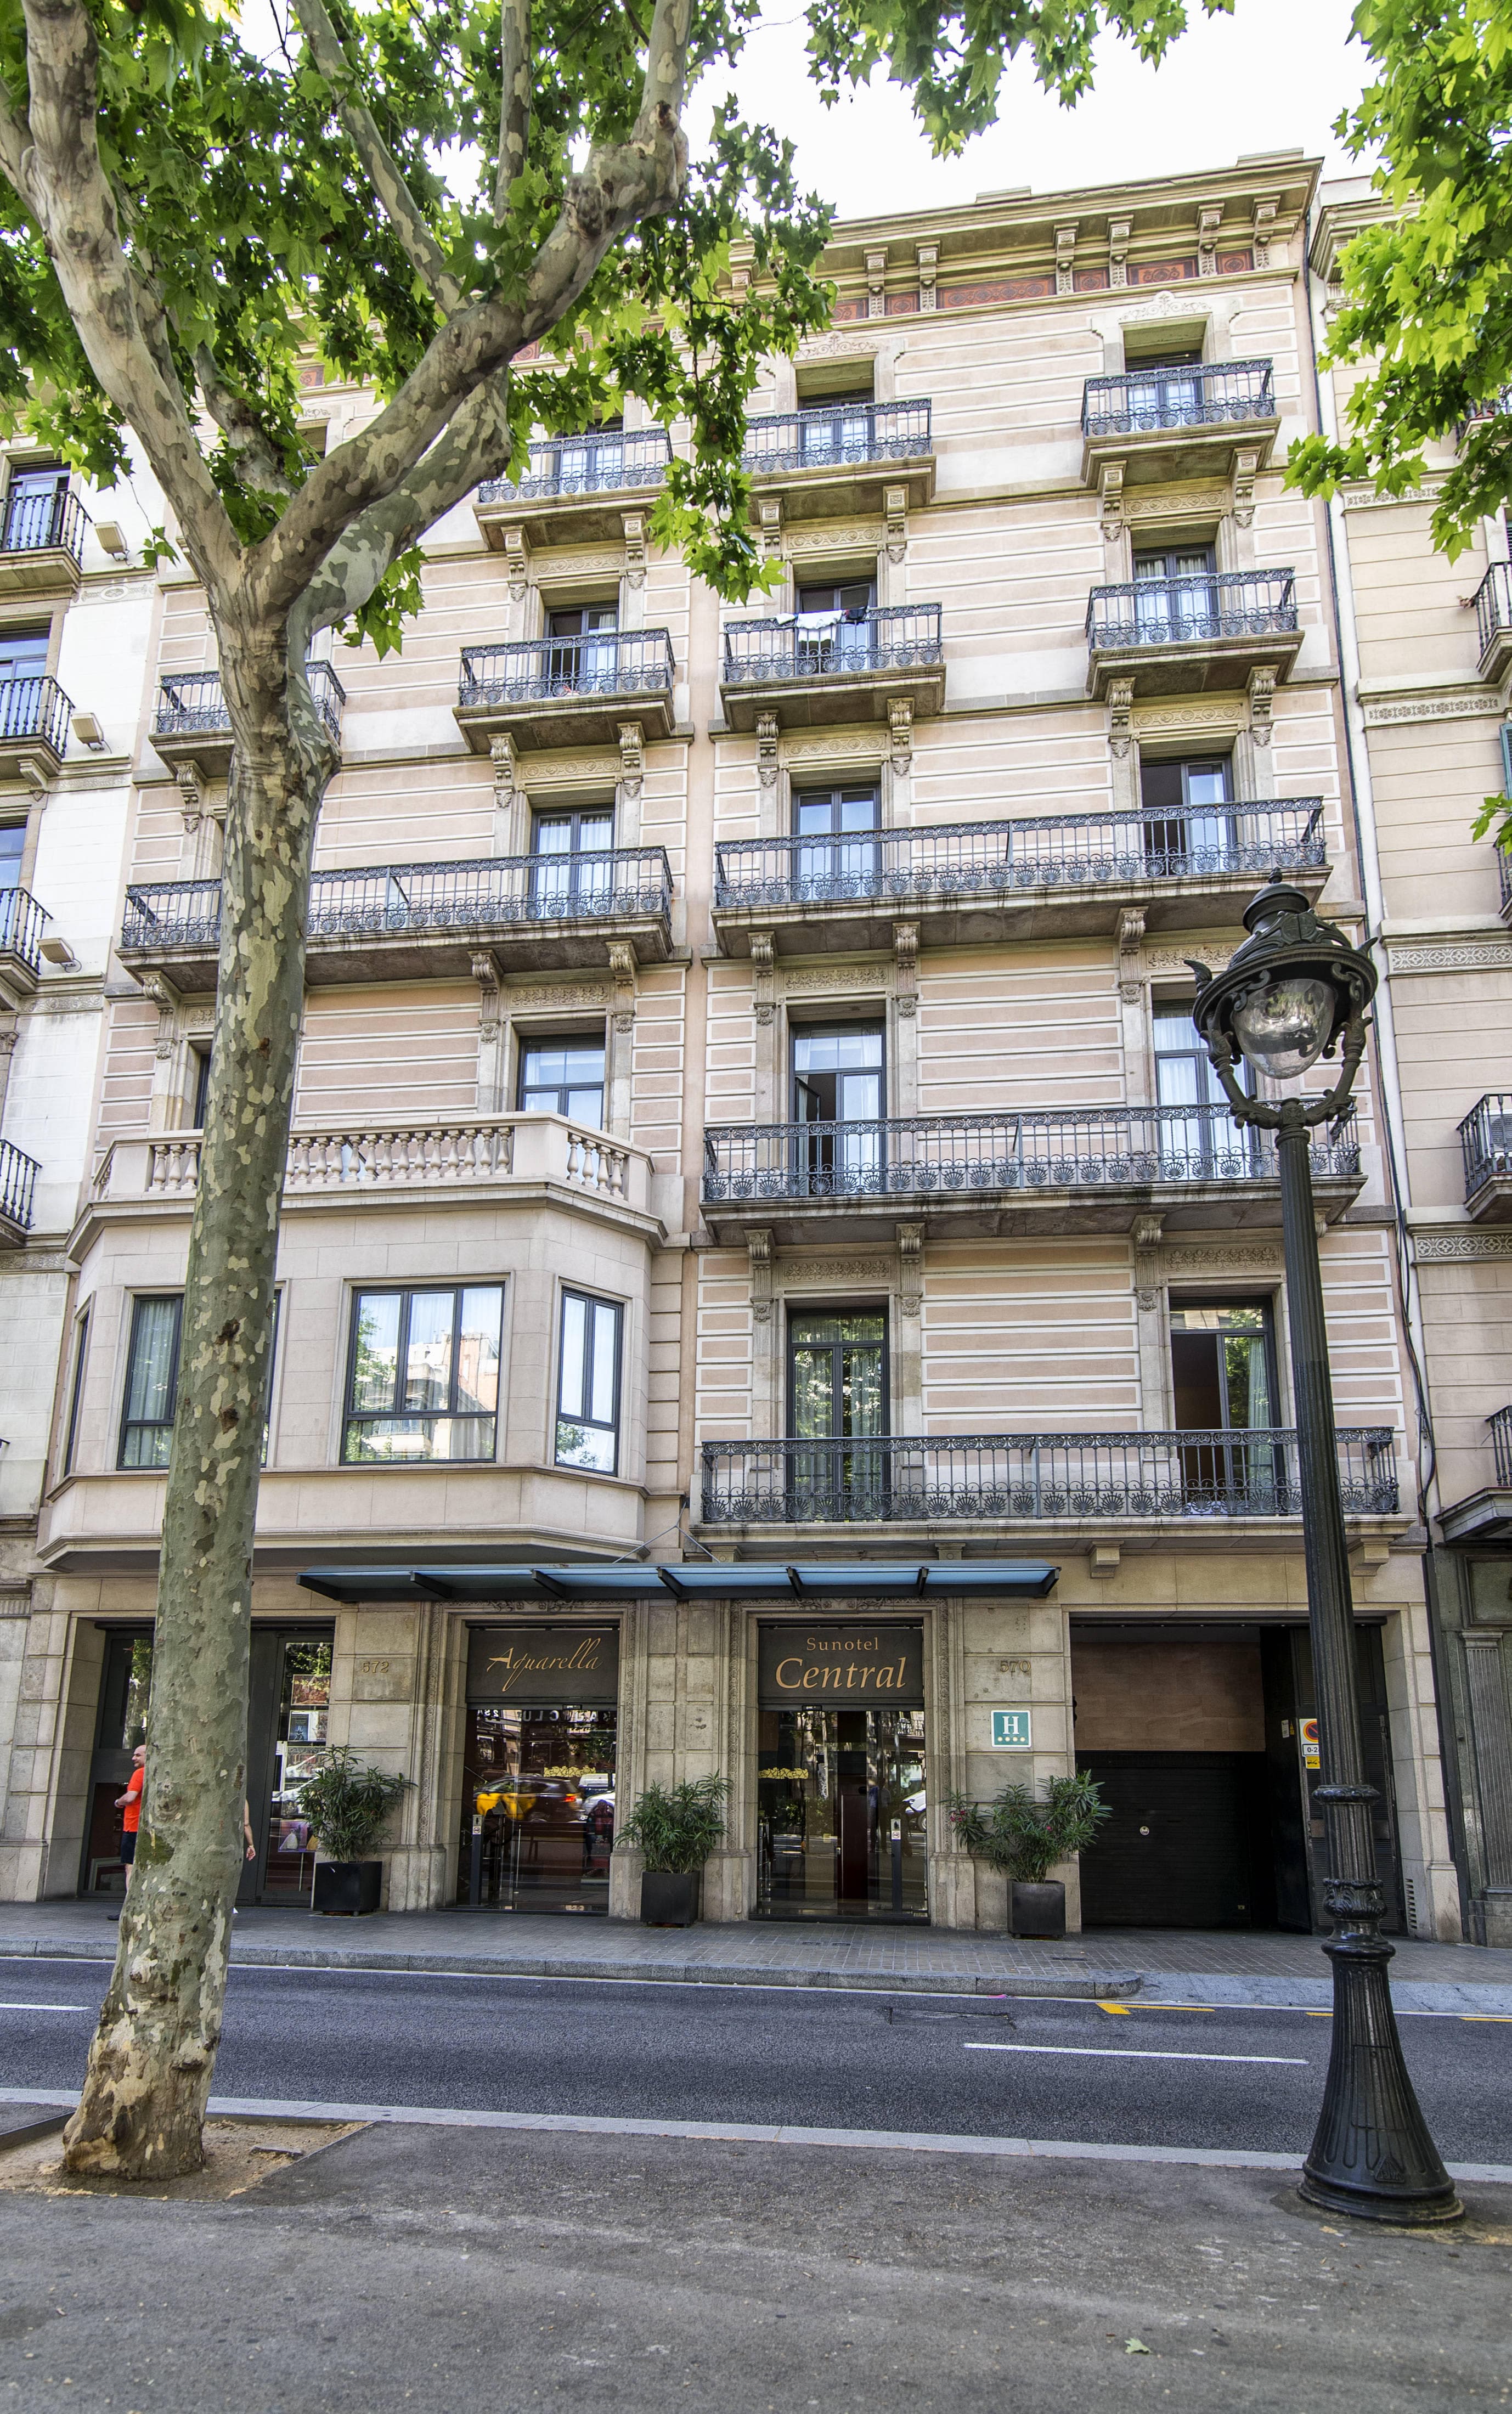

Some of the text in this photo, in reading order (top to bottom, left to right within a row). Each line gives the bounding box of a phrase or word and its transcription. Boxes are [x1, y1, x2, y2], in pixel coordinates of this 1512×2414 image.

[806, 1637, 879, 1651] Sunotel
[361, 1661, 389, 1673] 572
[487, 1638, 603, 1692] Aquarella
[775, 1657, 907, 1689] Central
[1000, 1660, 1031, 1673] 570
[1002, 1716, 1020, 1735] H
